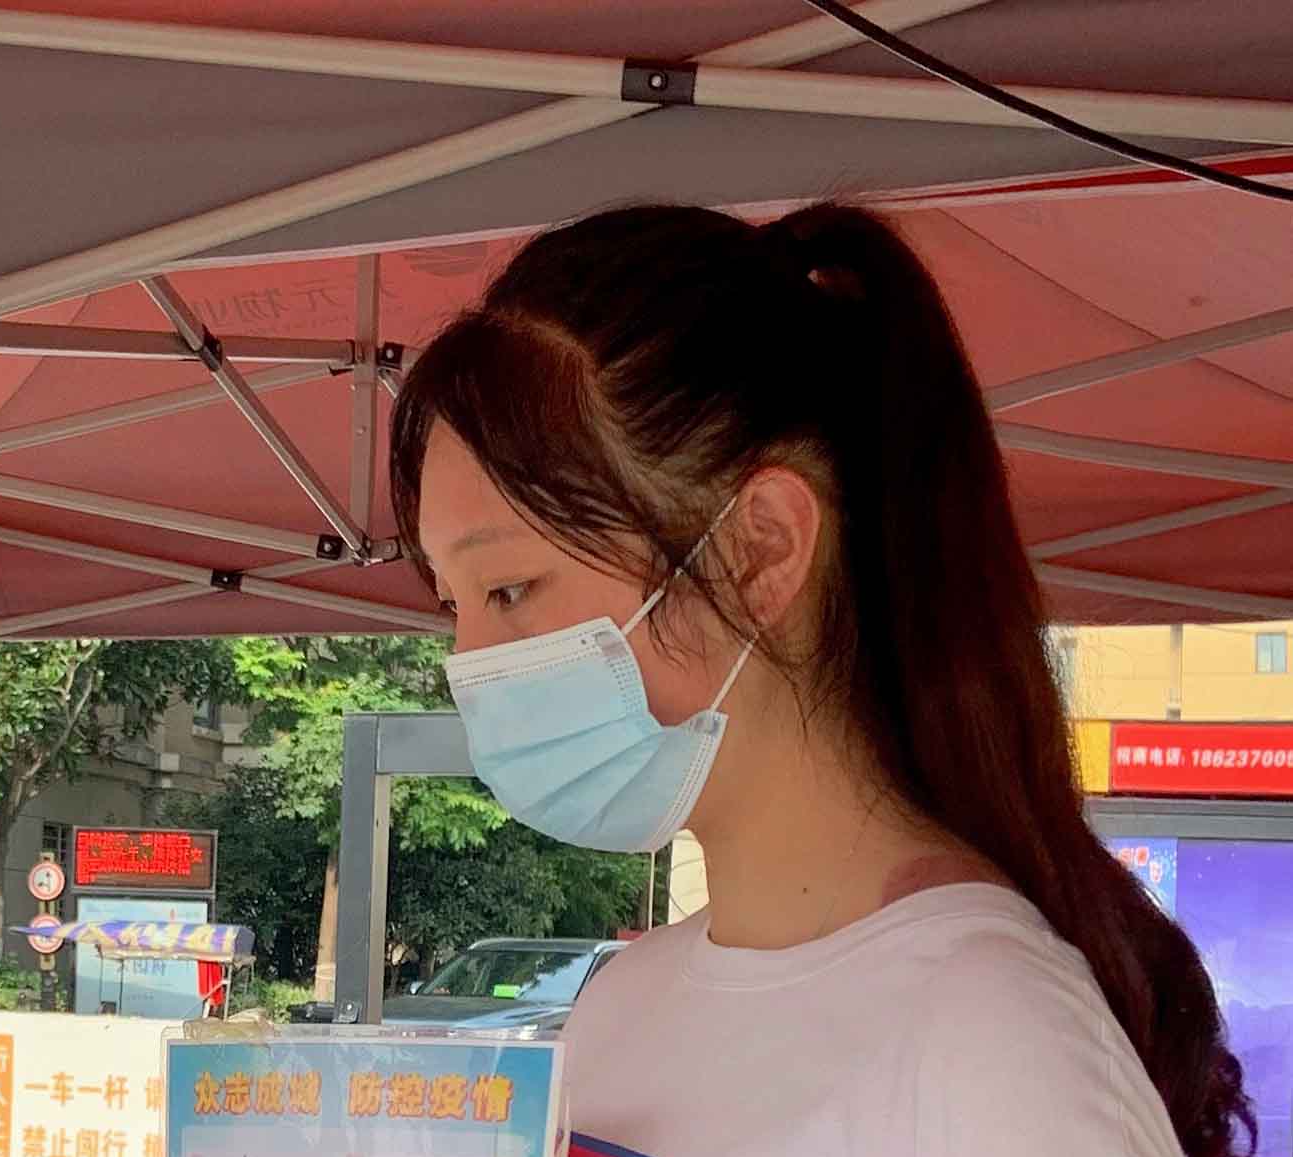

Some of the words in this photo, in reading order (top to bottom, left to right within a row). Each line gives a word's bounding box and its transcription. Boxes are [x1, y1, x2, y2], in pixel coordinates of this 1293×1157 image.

[23, 1071, 130, 1110] 一车一杆
[193, 1072, 323, 1116] 众志成城
[348, 1072, 514, 1122] 防控疫情
